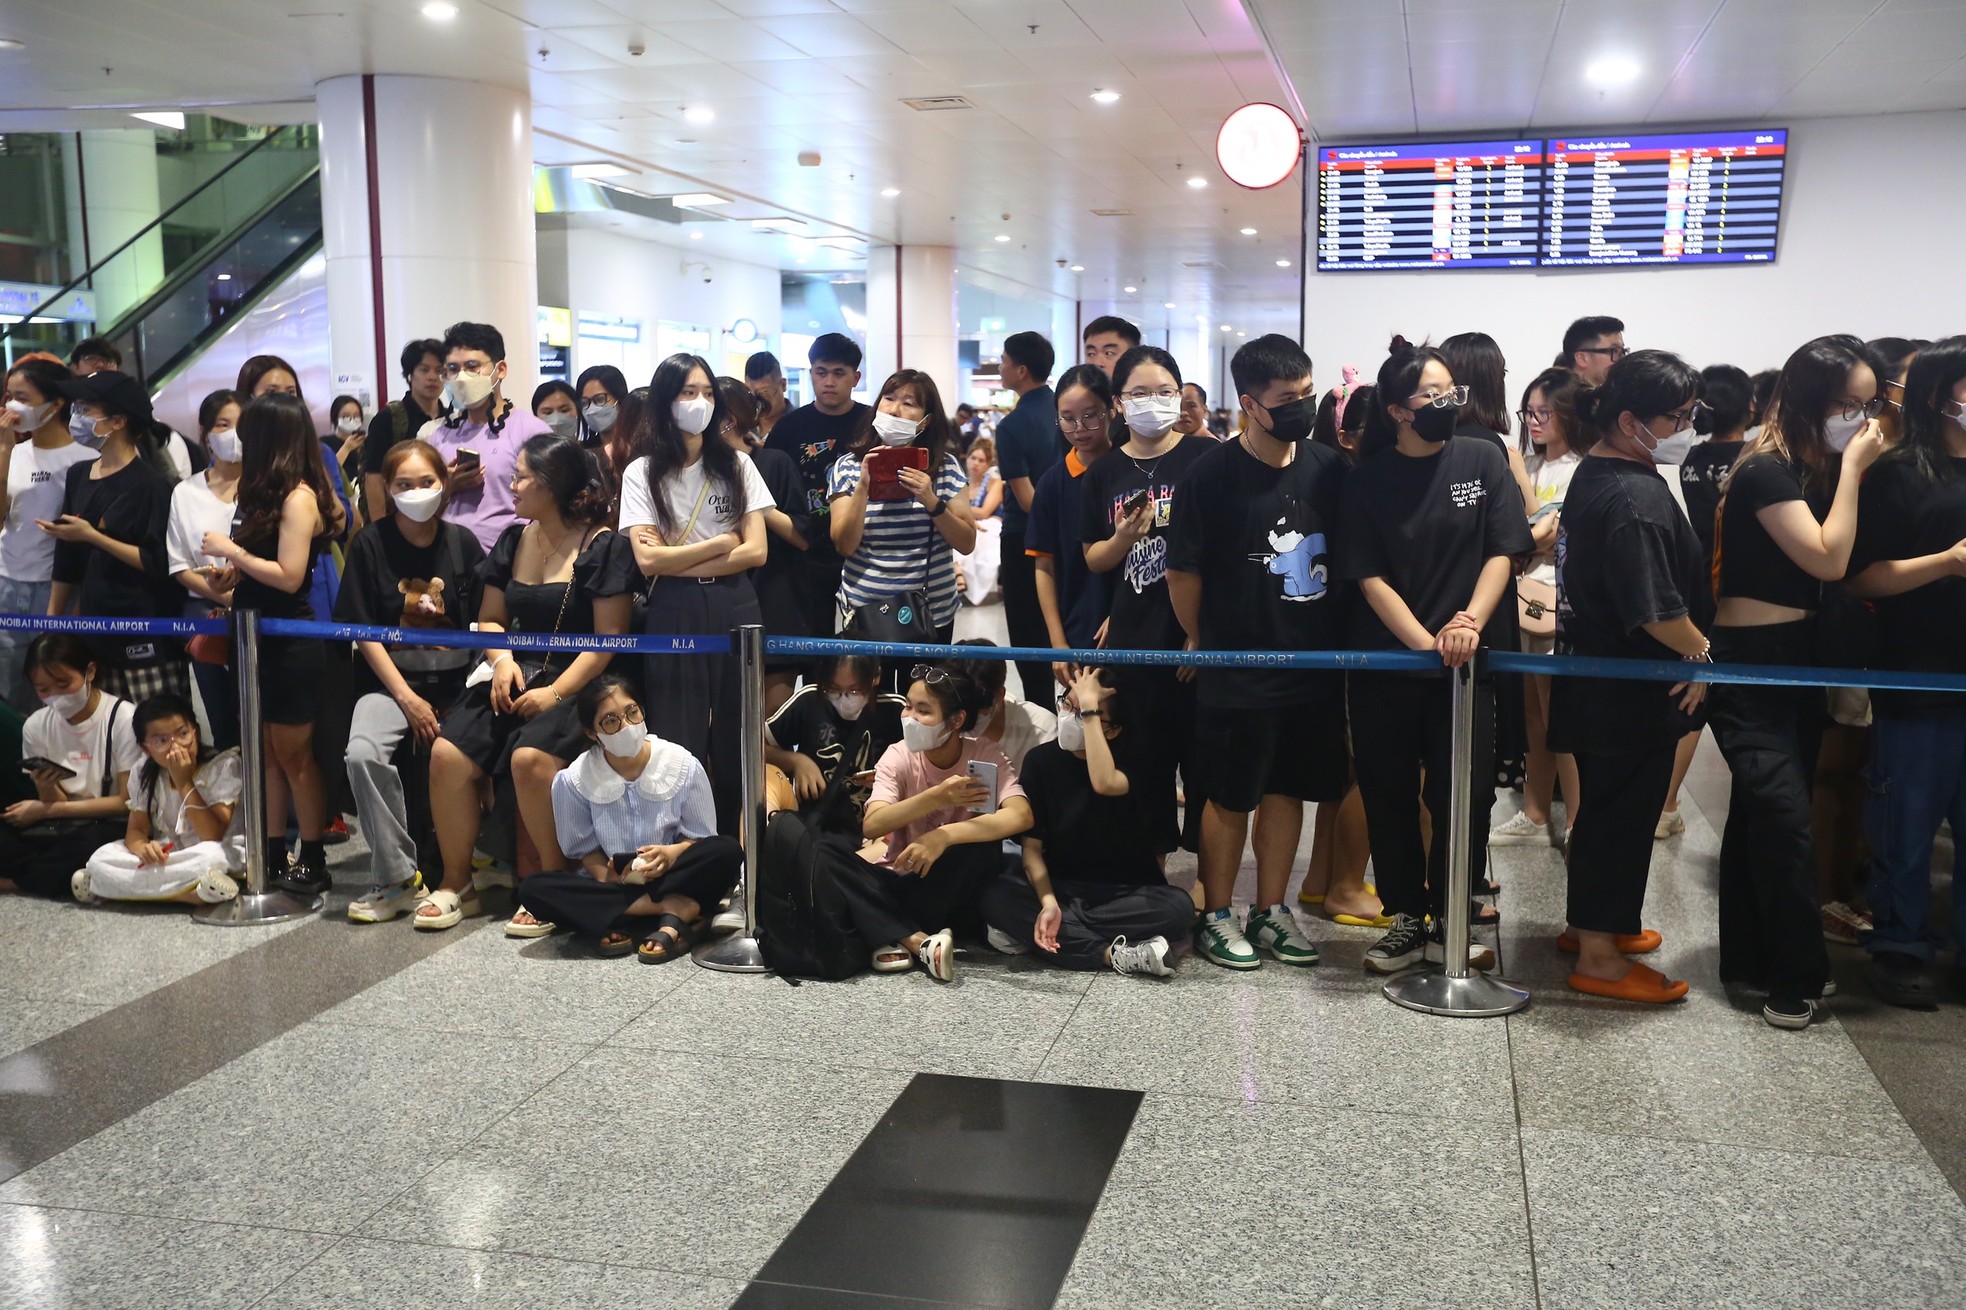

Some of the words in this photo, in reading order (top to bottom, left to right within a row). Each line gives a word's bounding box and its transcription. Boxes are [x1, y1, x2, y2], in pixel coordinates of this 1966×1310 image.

[1127, 538, 1164, 570] uisine
[0, 617, 31, 628] NOIBAI
[33, 619, 107, 631] INTERNATIONAL
[110, 621, 150, 632] AIRPORT
[173, 621, 196, 632] N.I.A
[536, 637, 600, 648] IERNAIONAL
[602, 637, 638, 648] AIRPORT
[672, 638, 695, 649] N.I.A
[1122, 653, 1230, 665] INTERNATIONAL
[1234, 654, 1295, 665] AIRPORT
